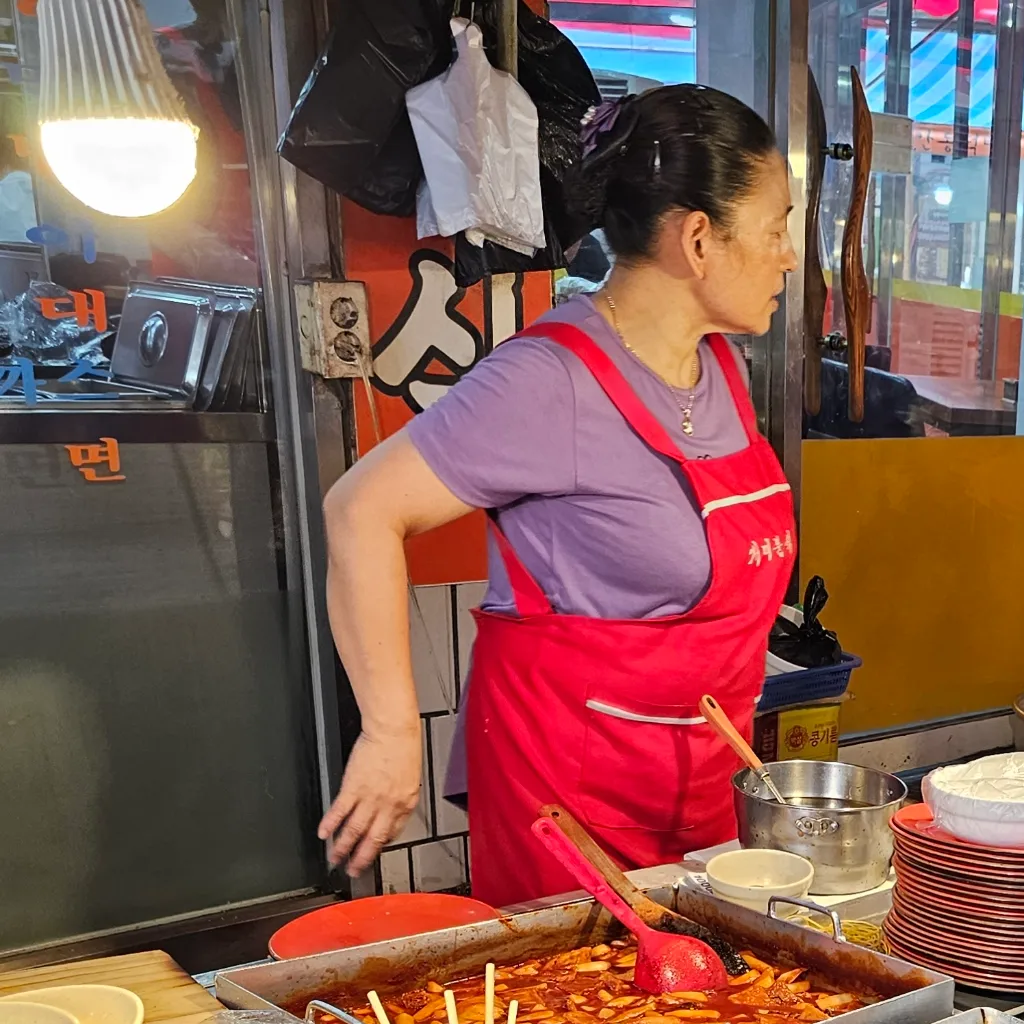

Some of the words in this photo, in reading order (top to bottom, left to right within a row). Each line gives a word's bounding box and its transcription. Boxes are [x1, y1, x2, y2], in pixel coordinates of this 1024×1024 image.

[36, 288, 108, 333] 대
[64, 436, 127, 482] 면
[809, 726, 839, 748] 콩기름
